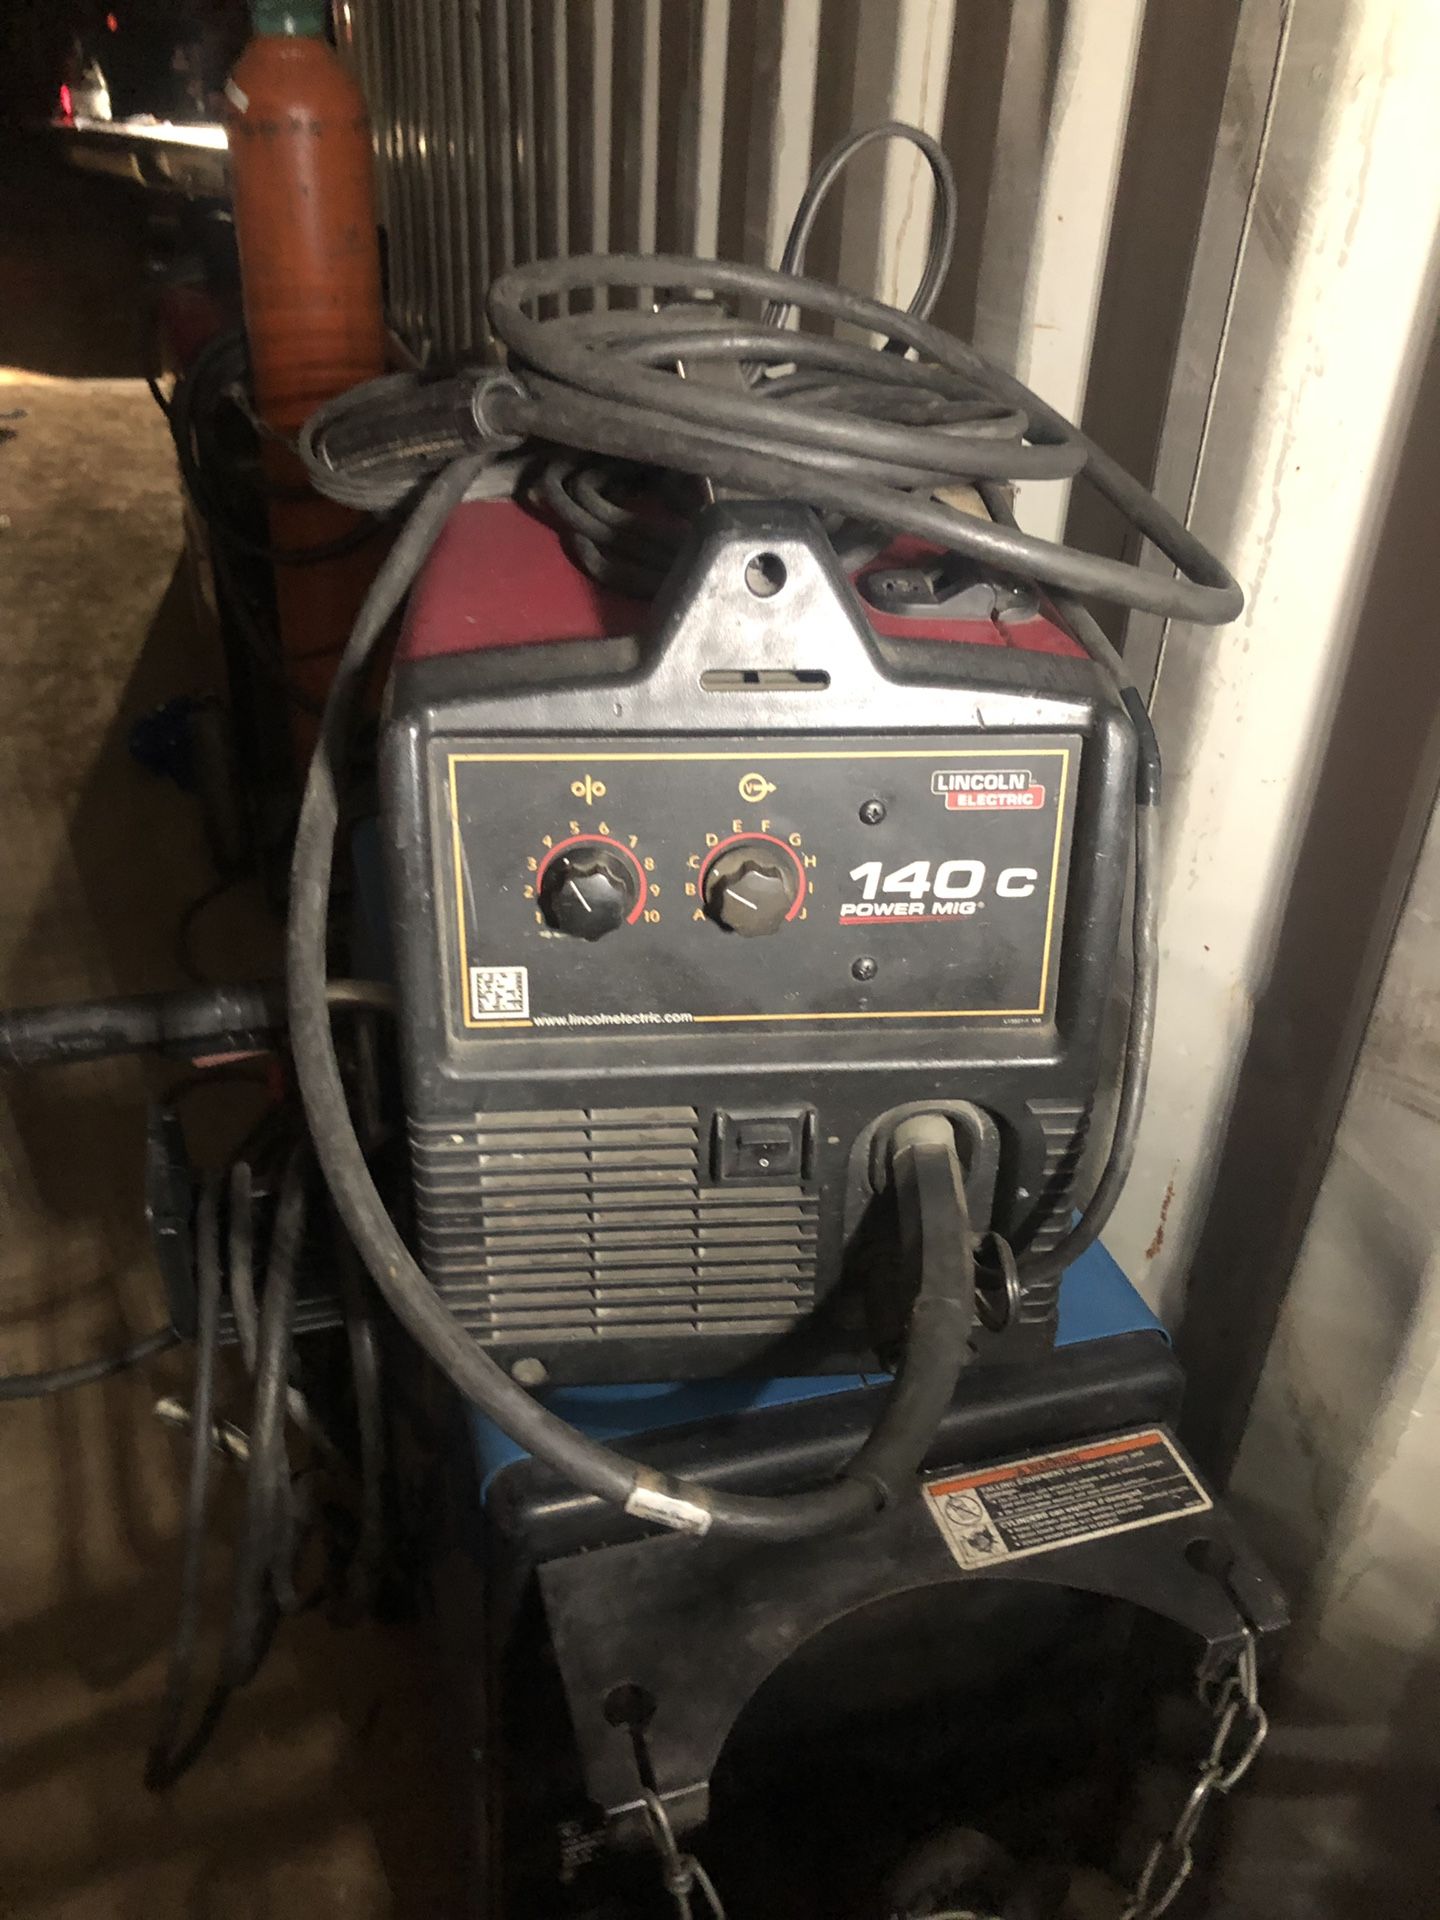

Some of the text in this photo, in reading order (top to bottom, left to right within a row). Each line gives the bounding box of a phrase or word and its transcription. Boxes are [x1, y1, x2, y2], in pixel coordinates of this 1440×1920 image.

[937, 774, 1026, 791] LINCOLN
[957, 793, 1034, 807] ELECTRIC
[569, 820, 581, 835] 5
[598, 821, 610, 835] 6
[732, 819, 743, 833] E
[761, 819, 771, 833] F
[542, 834, 553, 849] 4
[628, 834, 639, 849] 7
[705, 833, 719, 847] D
[788, 832, 802, 847] G
[527, 856, 538, 872] 3
[644, 856, 655, 872] 8
[687, 855, 700, 869] C
[803, 855, 817, 868] H
[849, 859, 986, 900] 140
[523, 884, 534, 899] 2
[649, 883, 661, 897] 9
[684, 883, 697, 896] B
[643, 908, 661, 924] 10
[692, 908, 706, 921] A
[840, 902, 925, 917] POWER
[535, 910, 543, 925] 1
[532, 1011, 693, 1027] www.lincolnelectric.com
